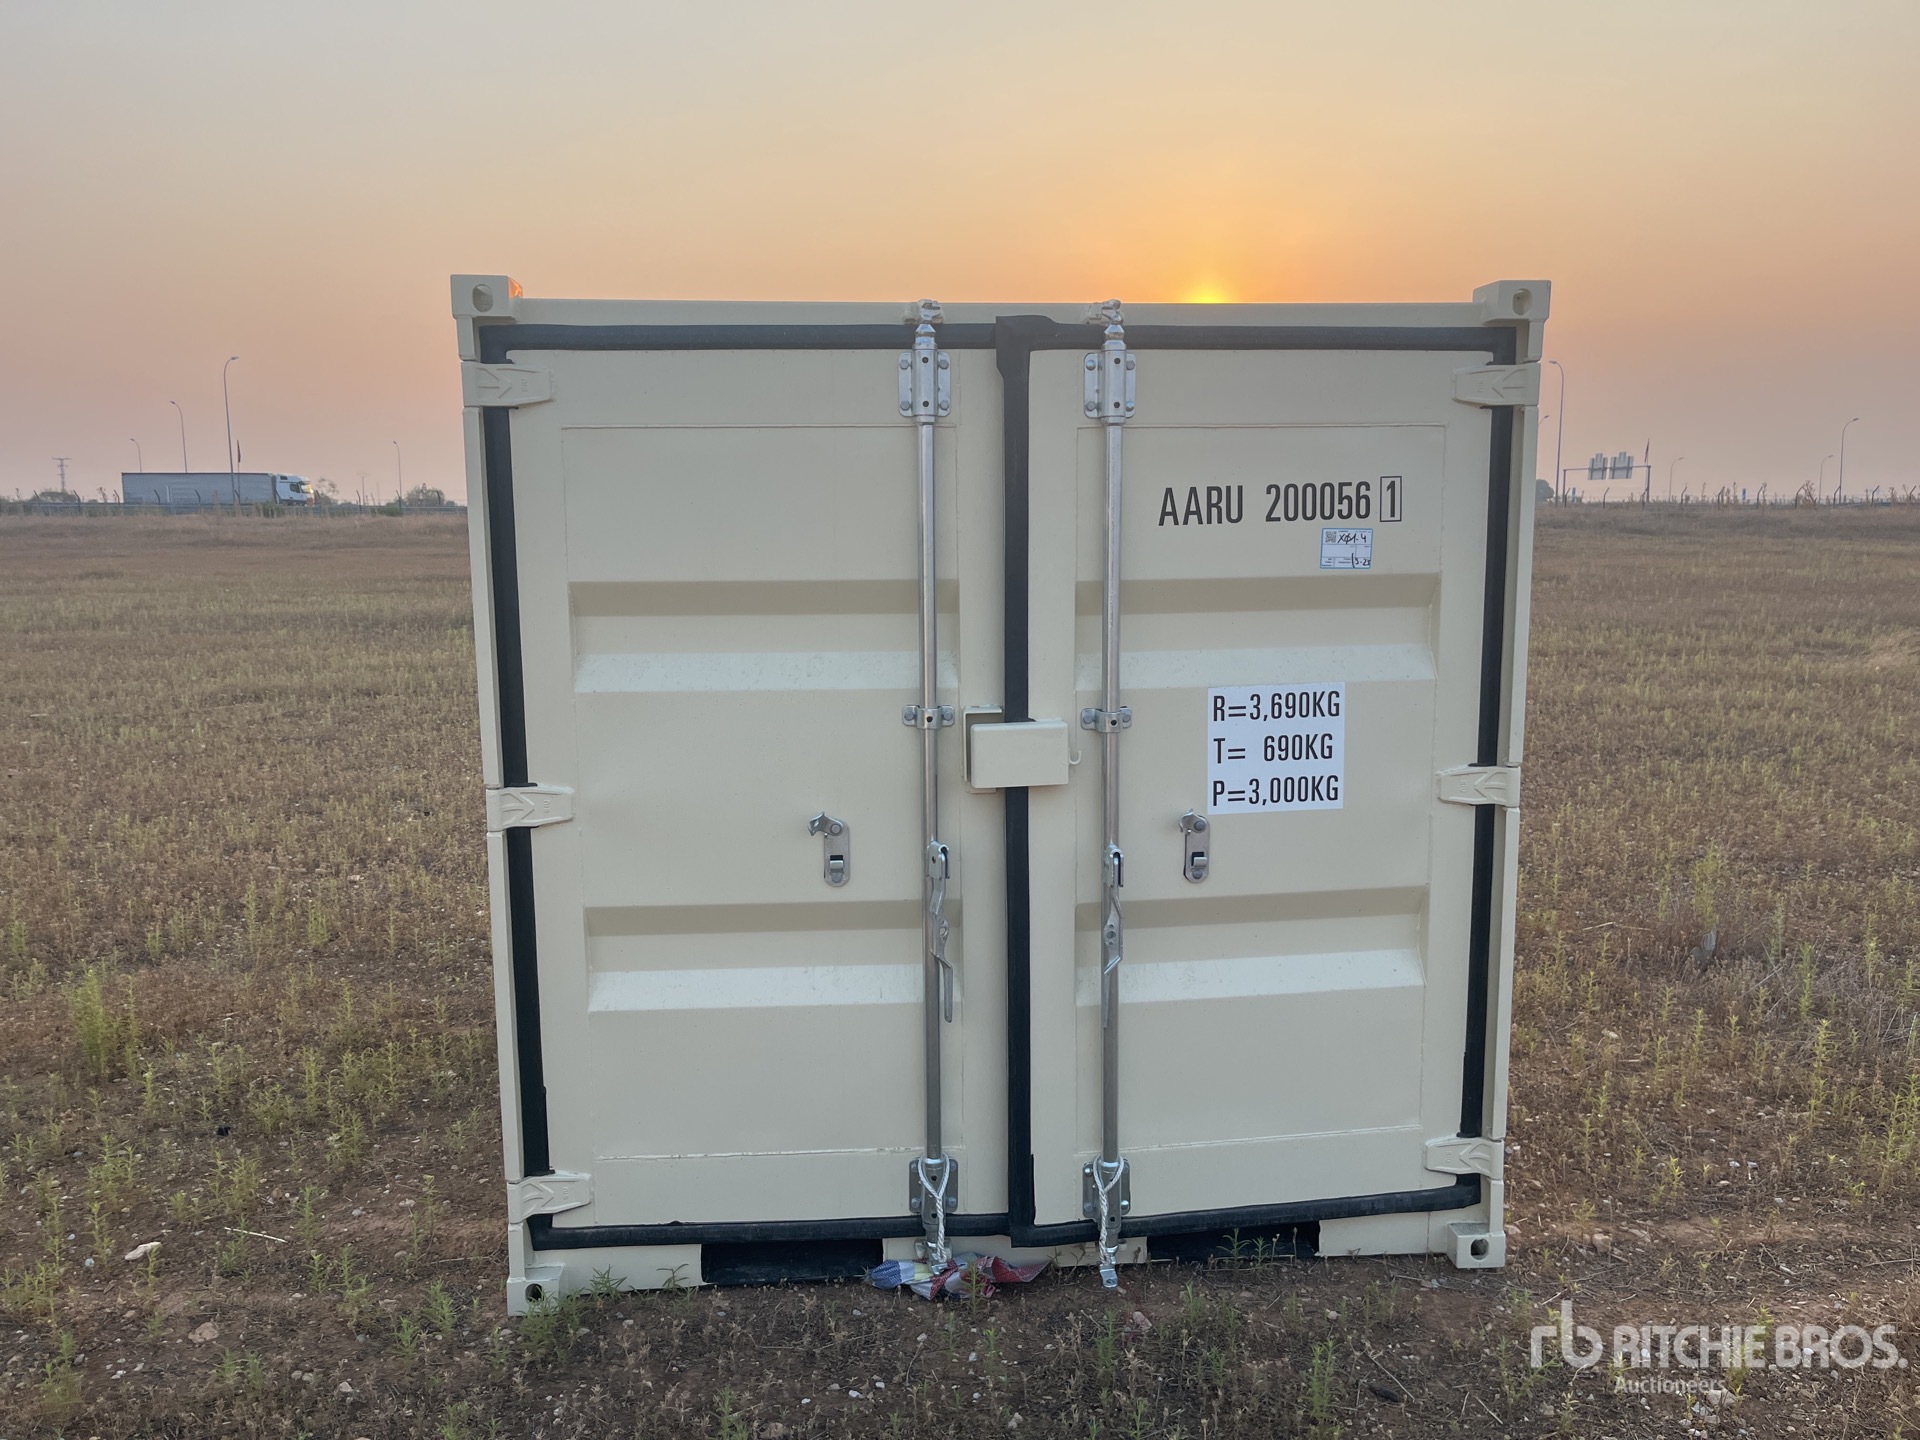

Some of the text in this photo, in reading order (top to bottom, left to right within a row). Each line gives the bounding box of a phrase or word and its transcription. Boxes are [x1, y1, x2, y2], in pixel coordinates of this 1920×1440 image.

[1158, 485, 1244, 526] AARU
[1265, 481, 1371, 522] 200056
[1212, 690, 1340, 722] R=3,690KG
[1213, 733, 1333, 764] T= 690KG
[1212, 774, 1339, 807] P=3,000KG
